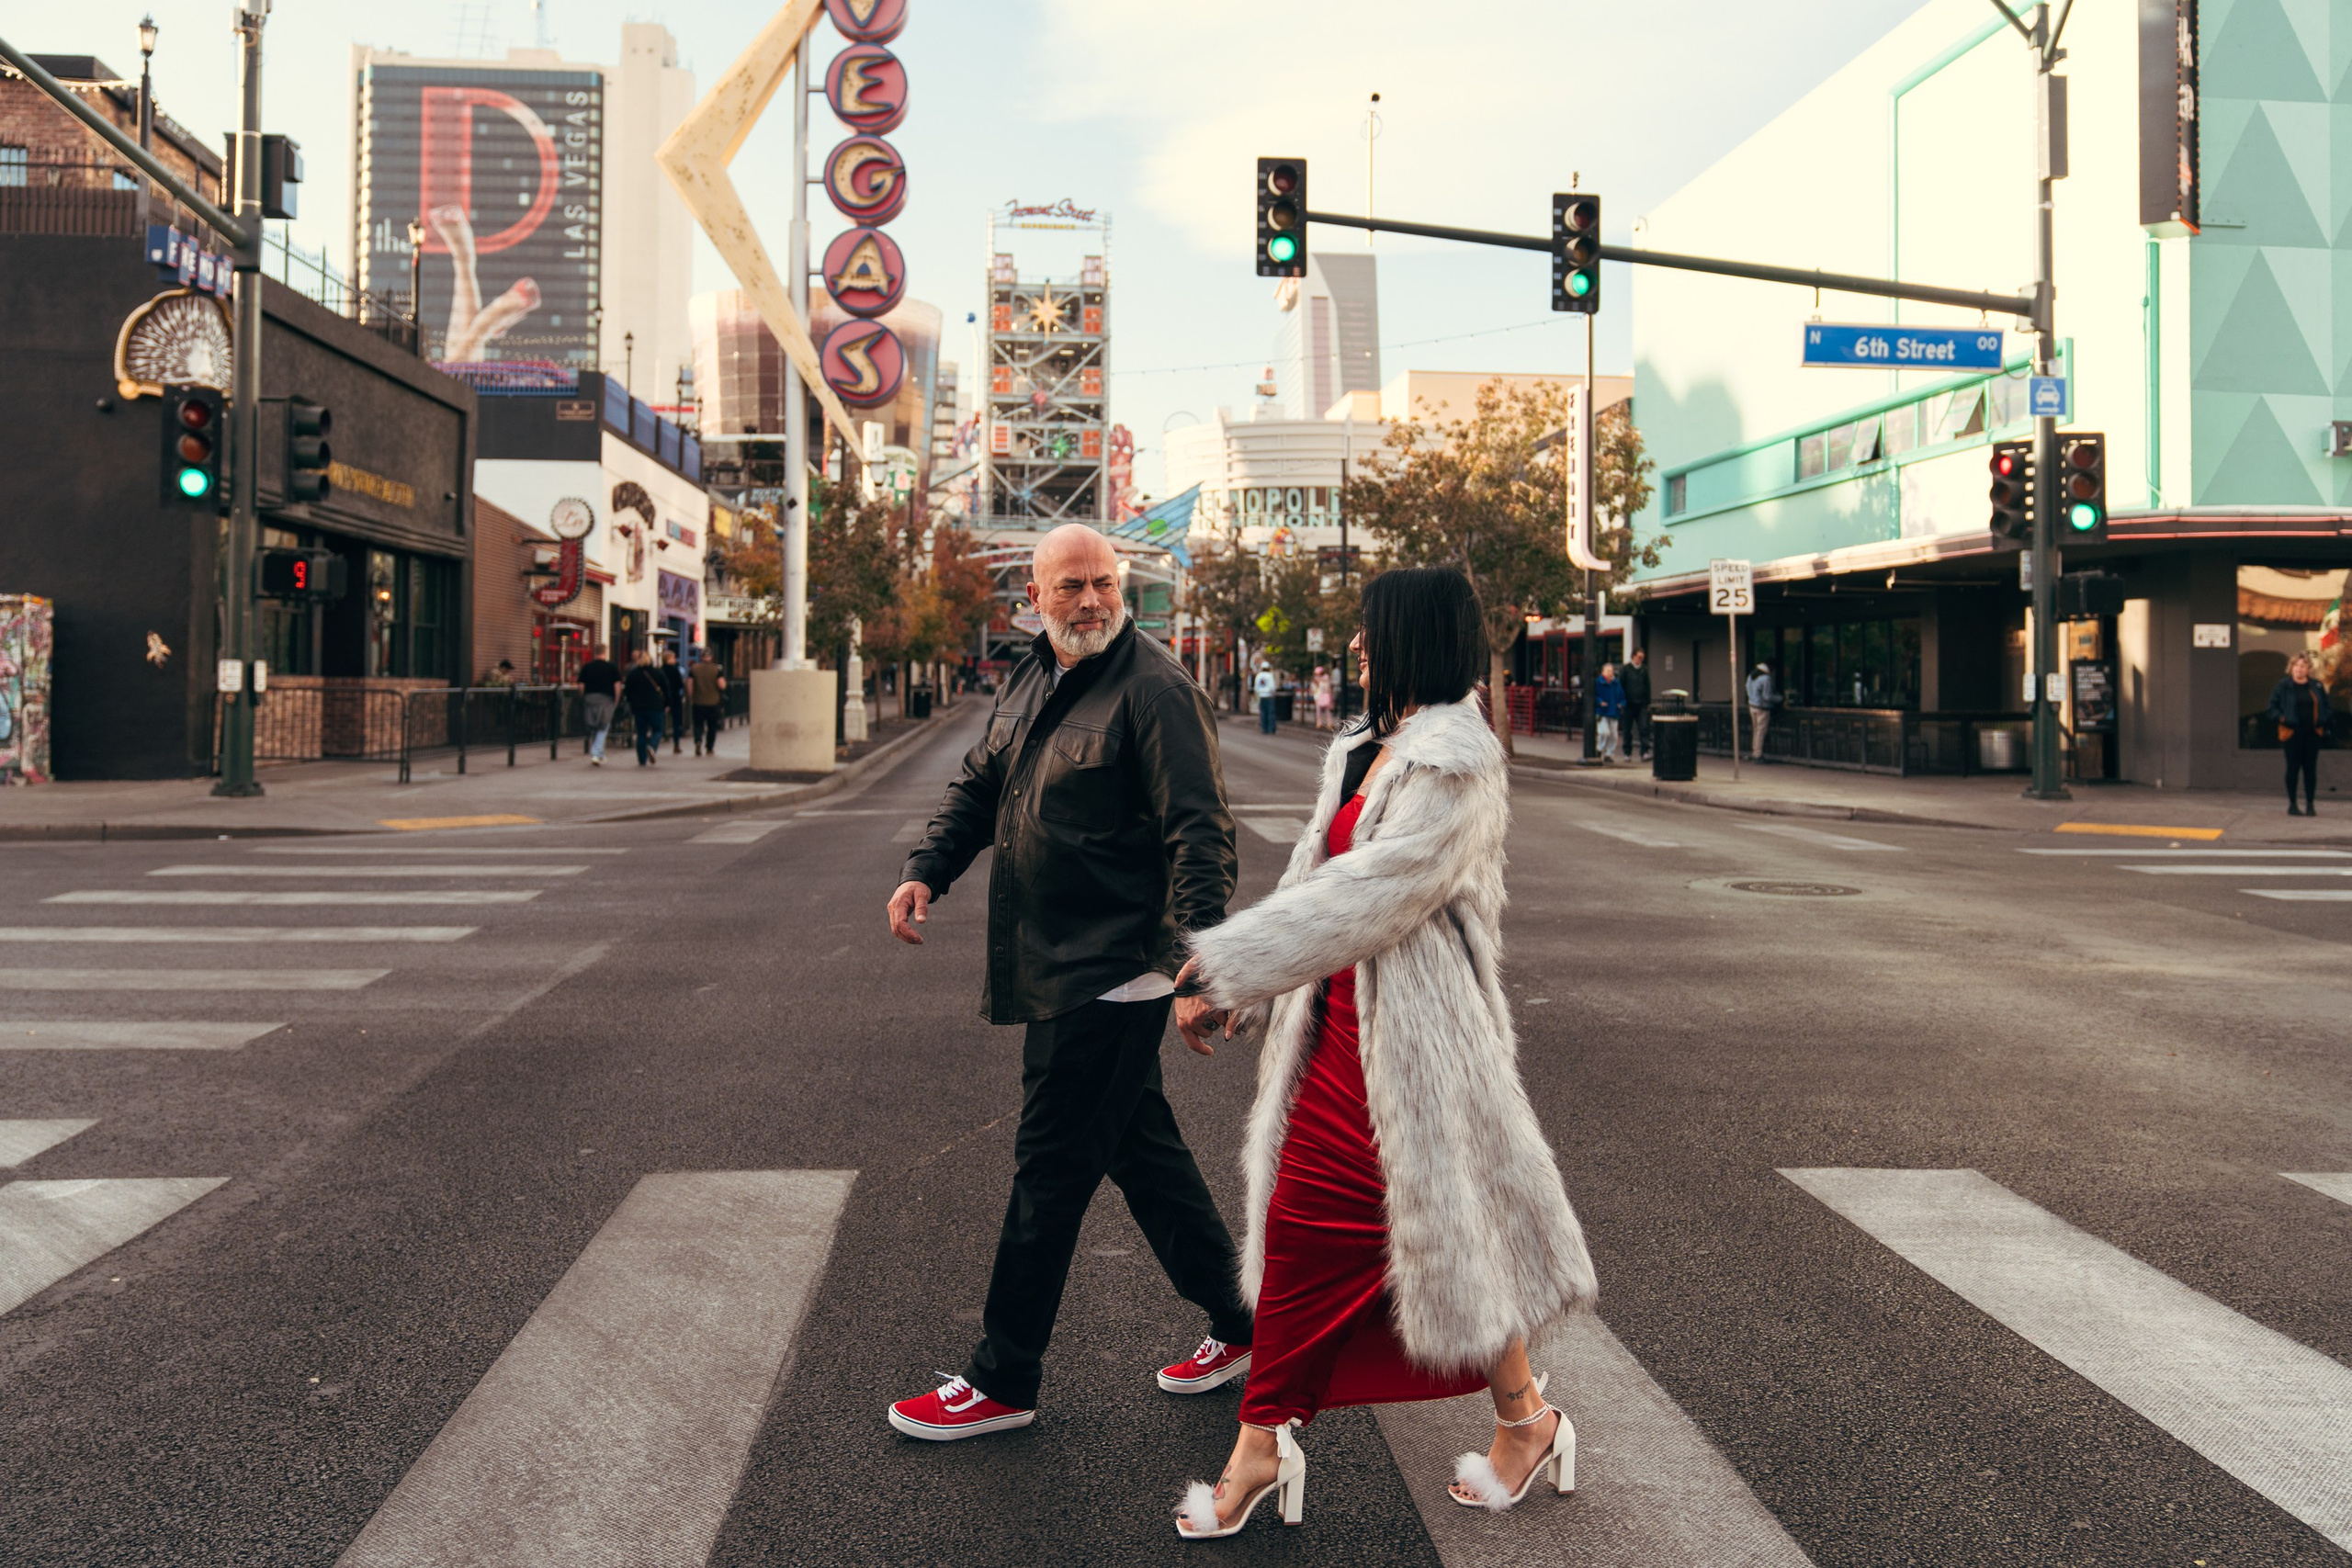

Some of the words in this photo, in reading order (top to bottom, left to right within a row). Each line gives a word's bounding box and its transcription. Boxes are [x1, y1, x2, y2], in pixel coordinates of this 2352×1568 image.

[564, 90, 588, 186] VEGAS
[374, 217, 415, 254] the
[419, 85, 560, 254] D
[563, 204, 586, 258] LAS
[1810, 331, 1821, 344] N
[1854, 336, 1889, 358] 6th
[1896, 337, 1955, 360] Street
[1713, 563, 1748, 572] SPEED
[1718, 575, 1745, 584] LIMIT
[1716, 588, 1748, 606] 25
